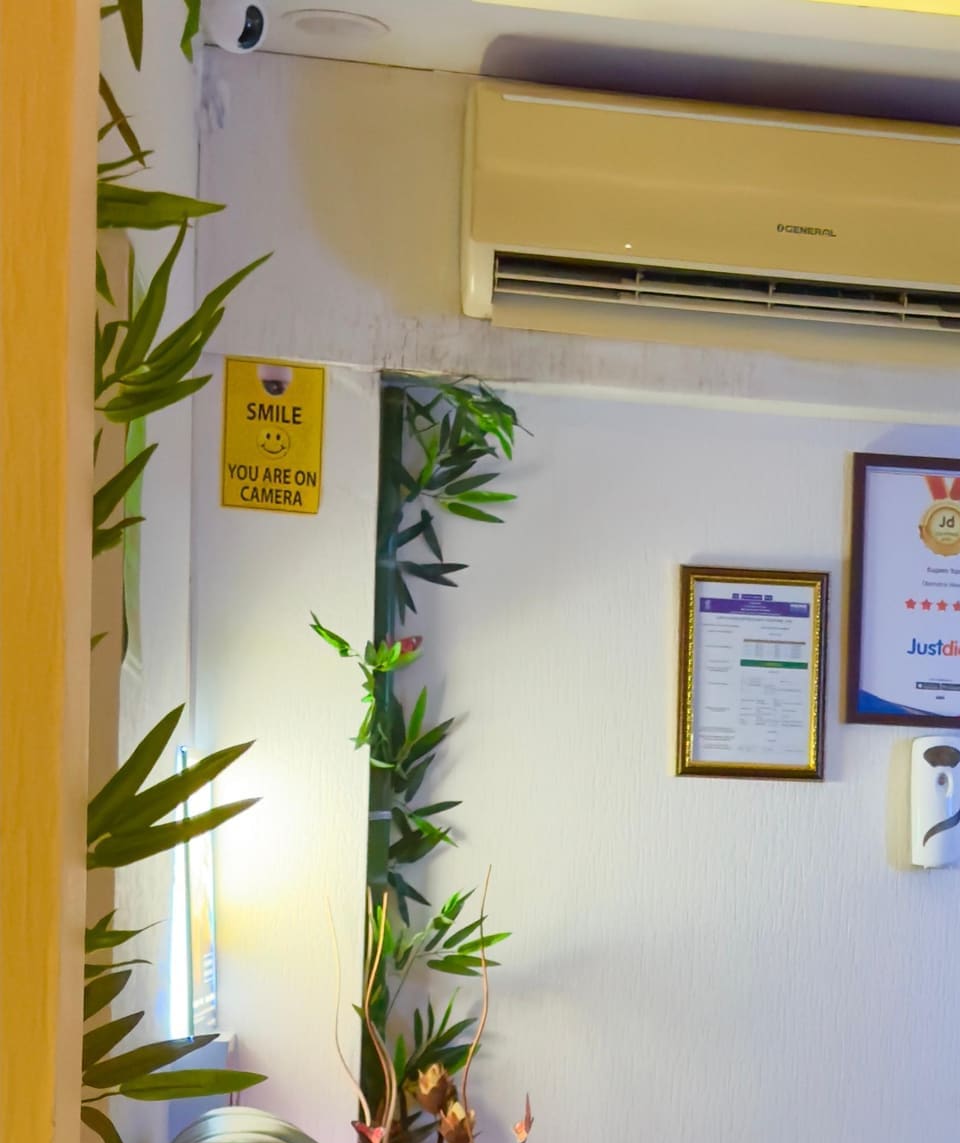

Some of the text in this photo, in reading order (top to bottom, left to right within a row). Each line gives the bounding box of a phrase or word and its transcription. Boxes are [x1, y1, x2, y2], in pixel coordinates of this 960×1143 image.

[247, 402, 302, 424] SMILE
[228, 464, 316, 487] YOU ARE ON
[240, 486, 303, 506] CAMERA
[939, 515, 955, 528] Jd
